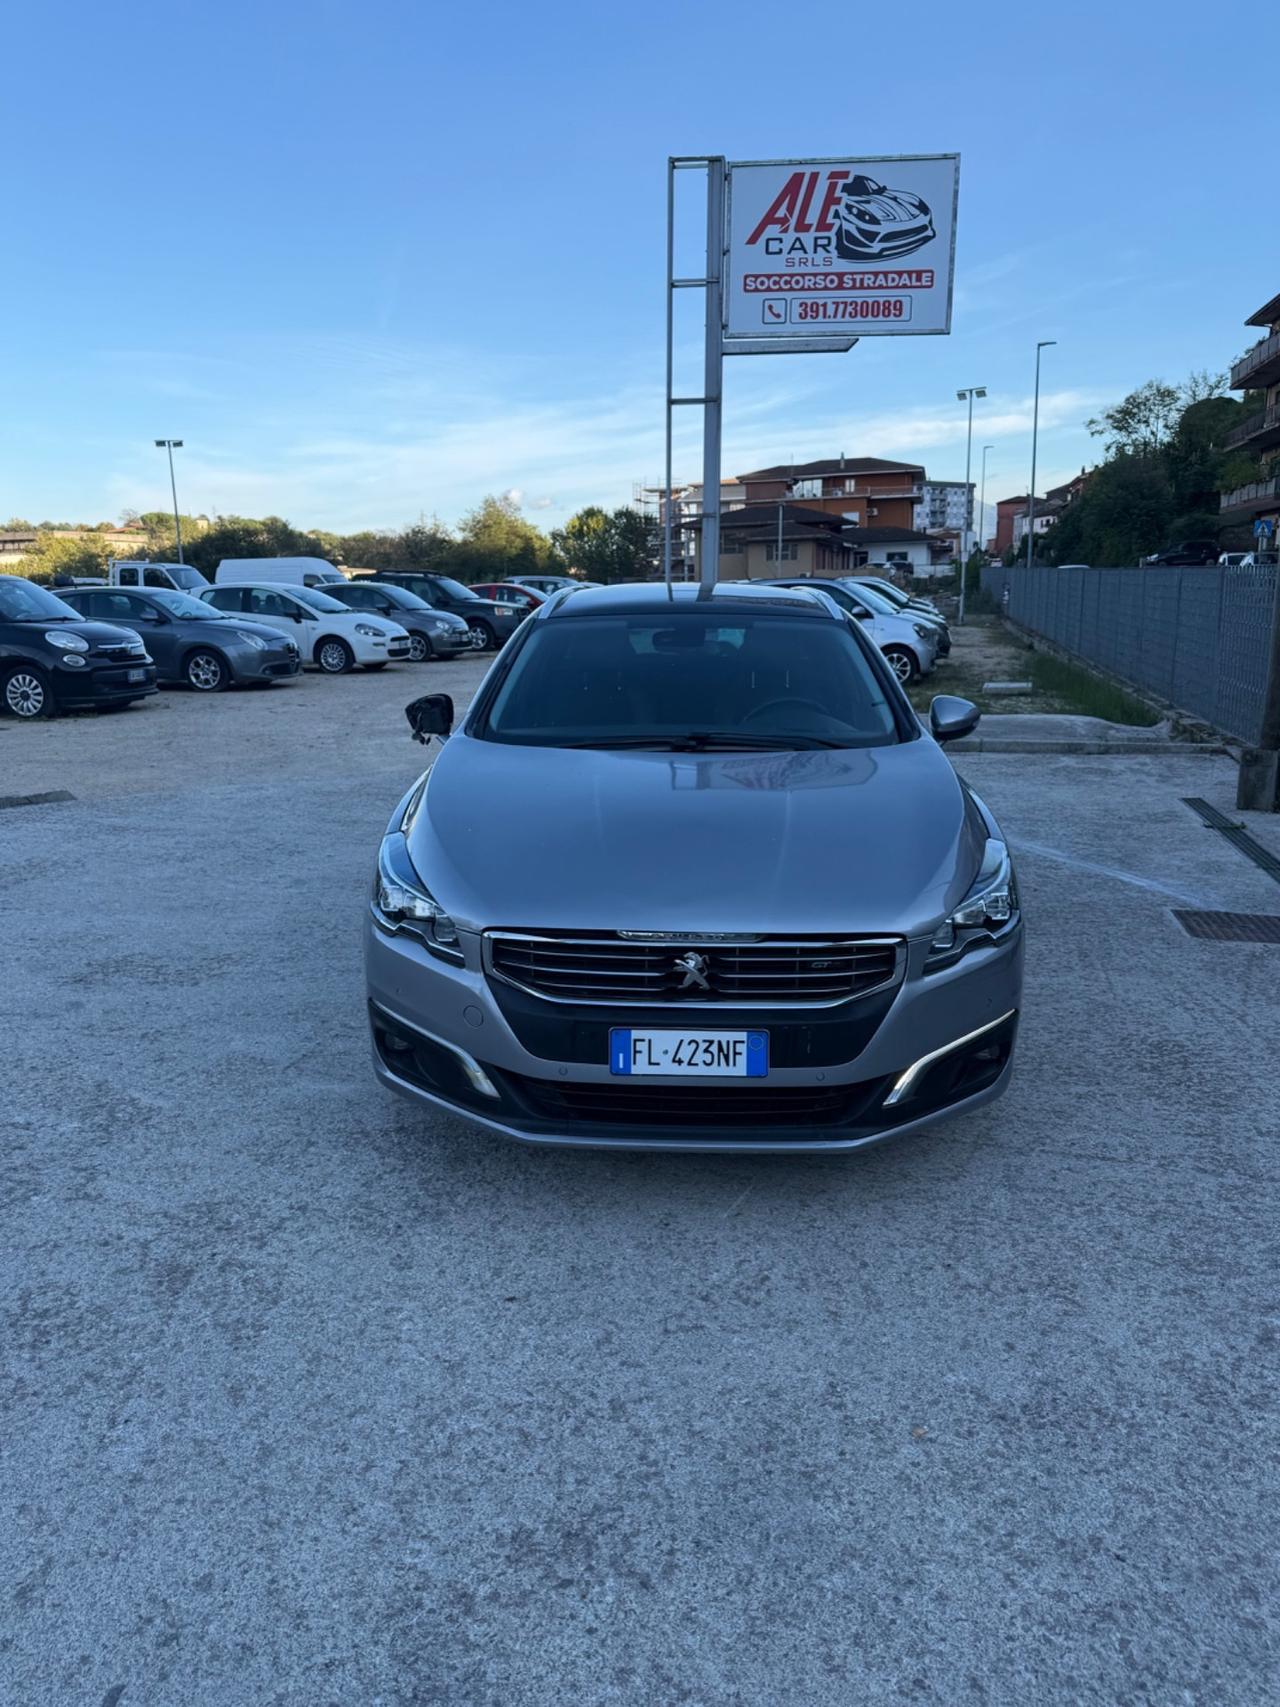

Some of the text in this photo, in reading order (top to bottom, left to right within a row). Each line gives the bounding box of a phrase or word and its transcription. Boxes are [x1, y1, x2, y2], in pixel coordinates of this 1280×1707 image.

[745, 170, 850, 245] ALE
[765, 236, 832, 255] CAR
[785, 257, 833, 268] SRLS
[745, 273, 932, 290] SOCCORSO STRADALE
[798, 300, 903, 320] 391.7730089
